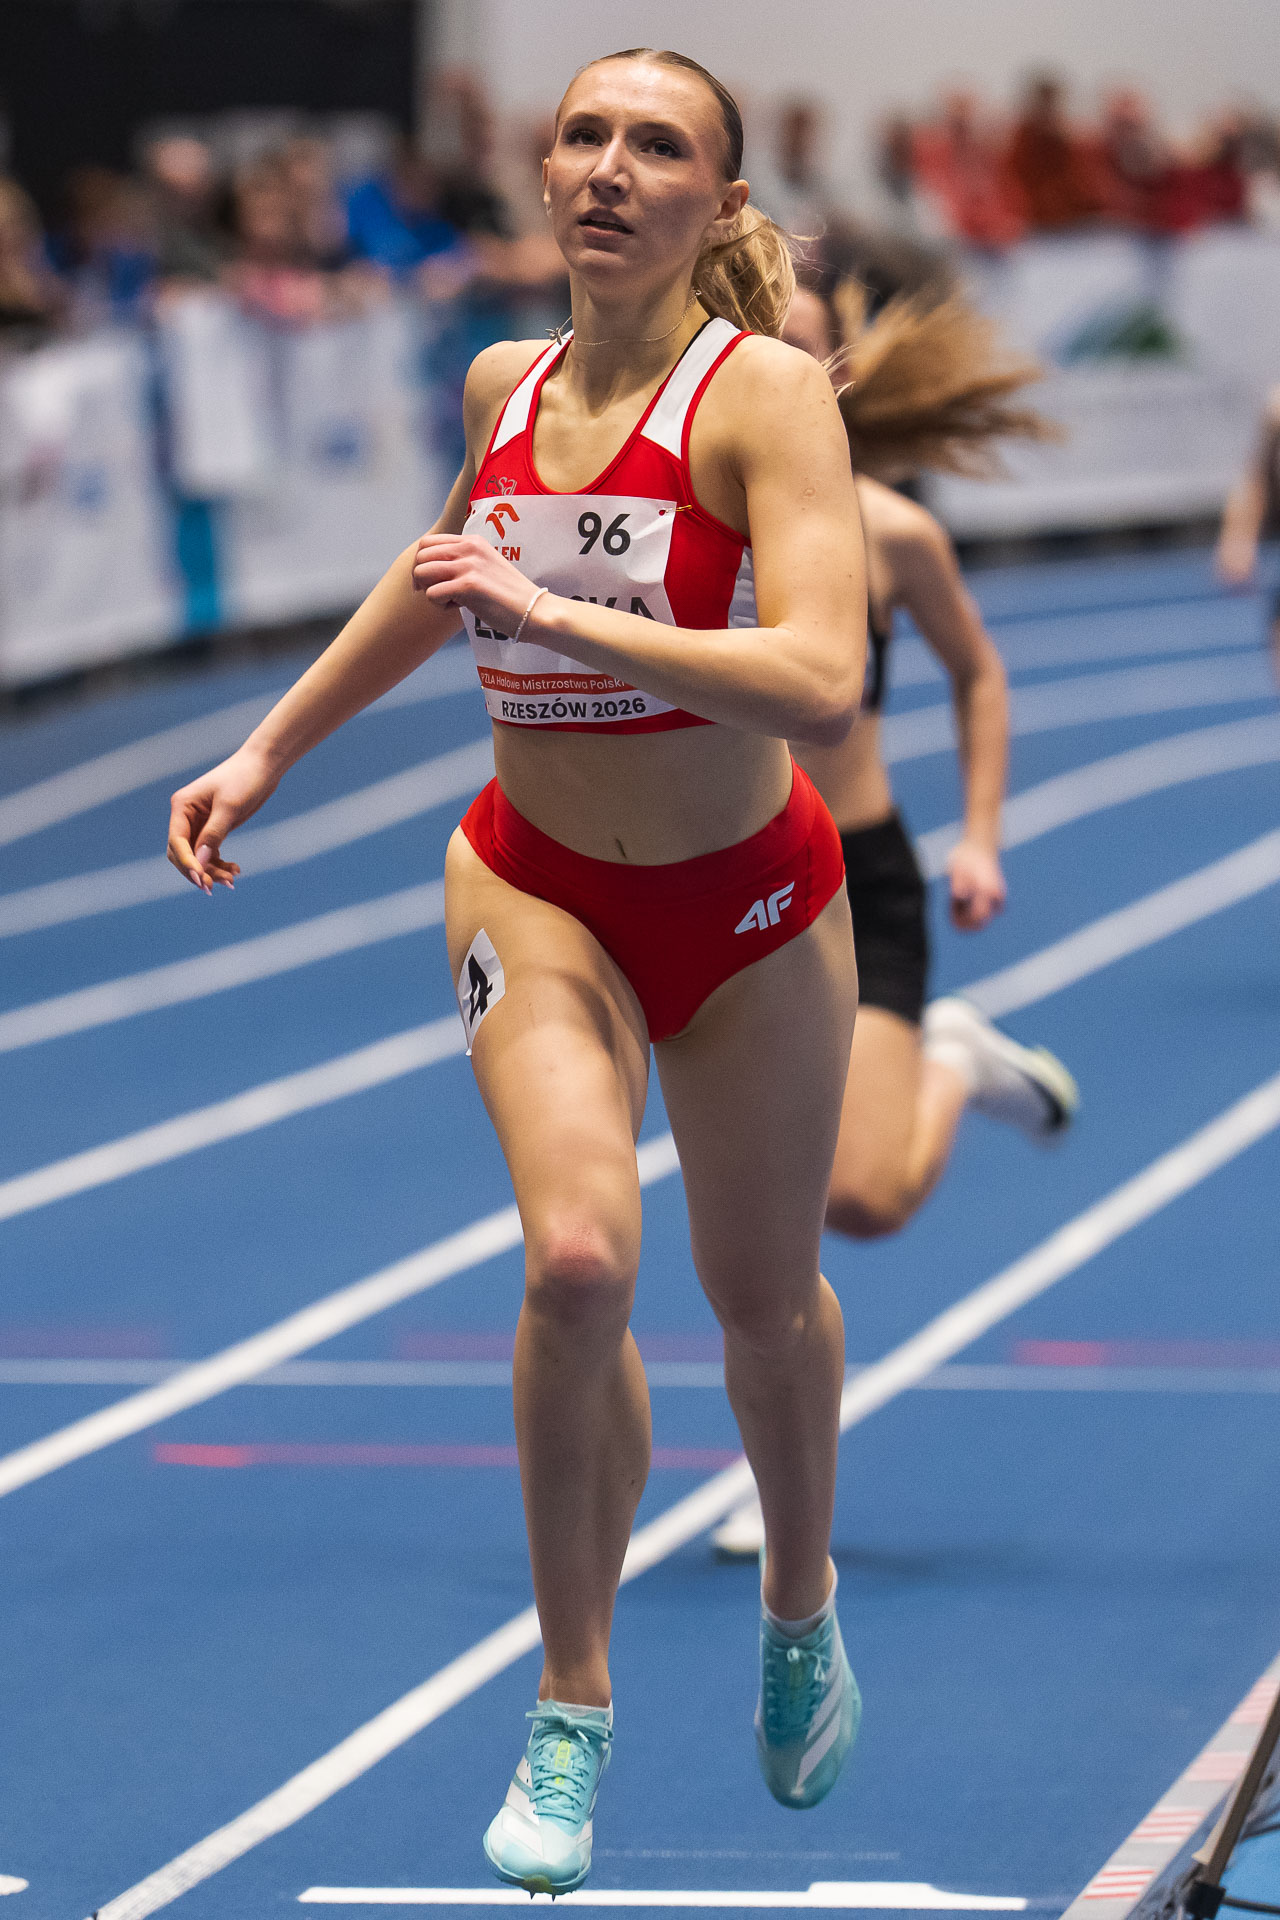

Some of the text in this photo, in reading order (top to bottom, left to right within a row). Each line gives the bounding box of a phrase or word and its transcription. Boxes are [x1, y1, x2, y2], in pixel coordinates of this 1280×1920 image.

[577, 511, 631, 556] 96
[496, 676, 520, 690] Halowe
[522, 679, 588, 690] Mistrzostwa
[502, 697, 646, 719] RZESZÓW 2026
[734, 880, 795, 934] 4F
[467, 953, 493, 1029] 4
